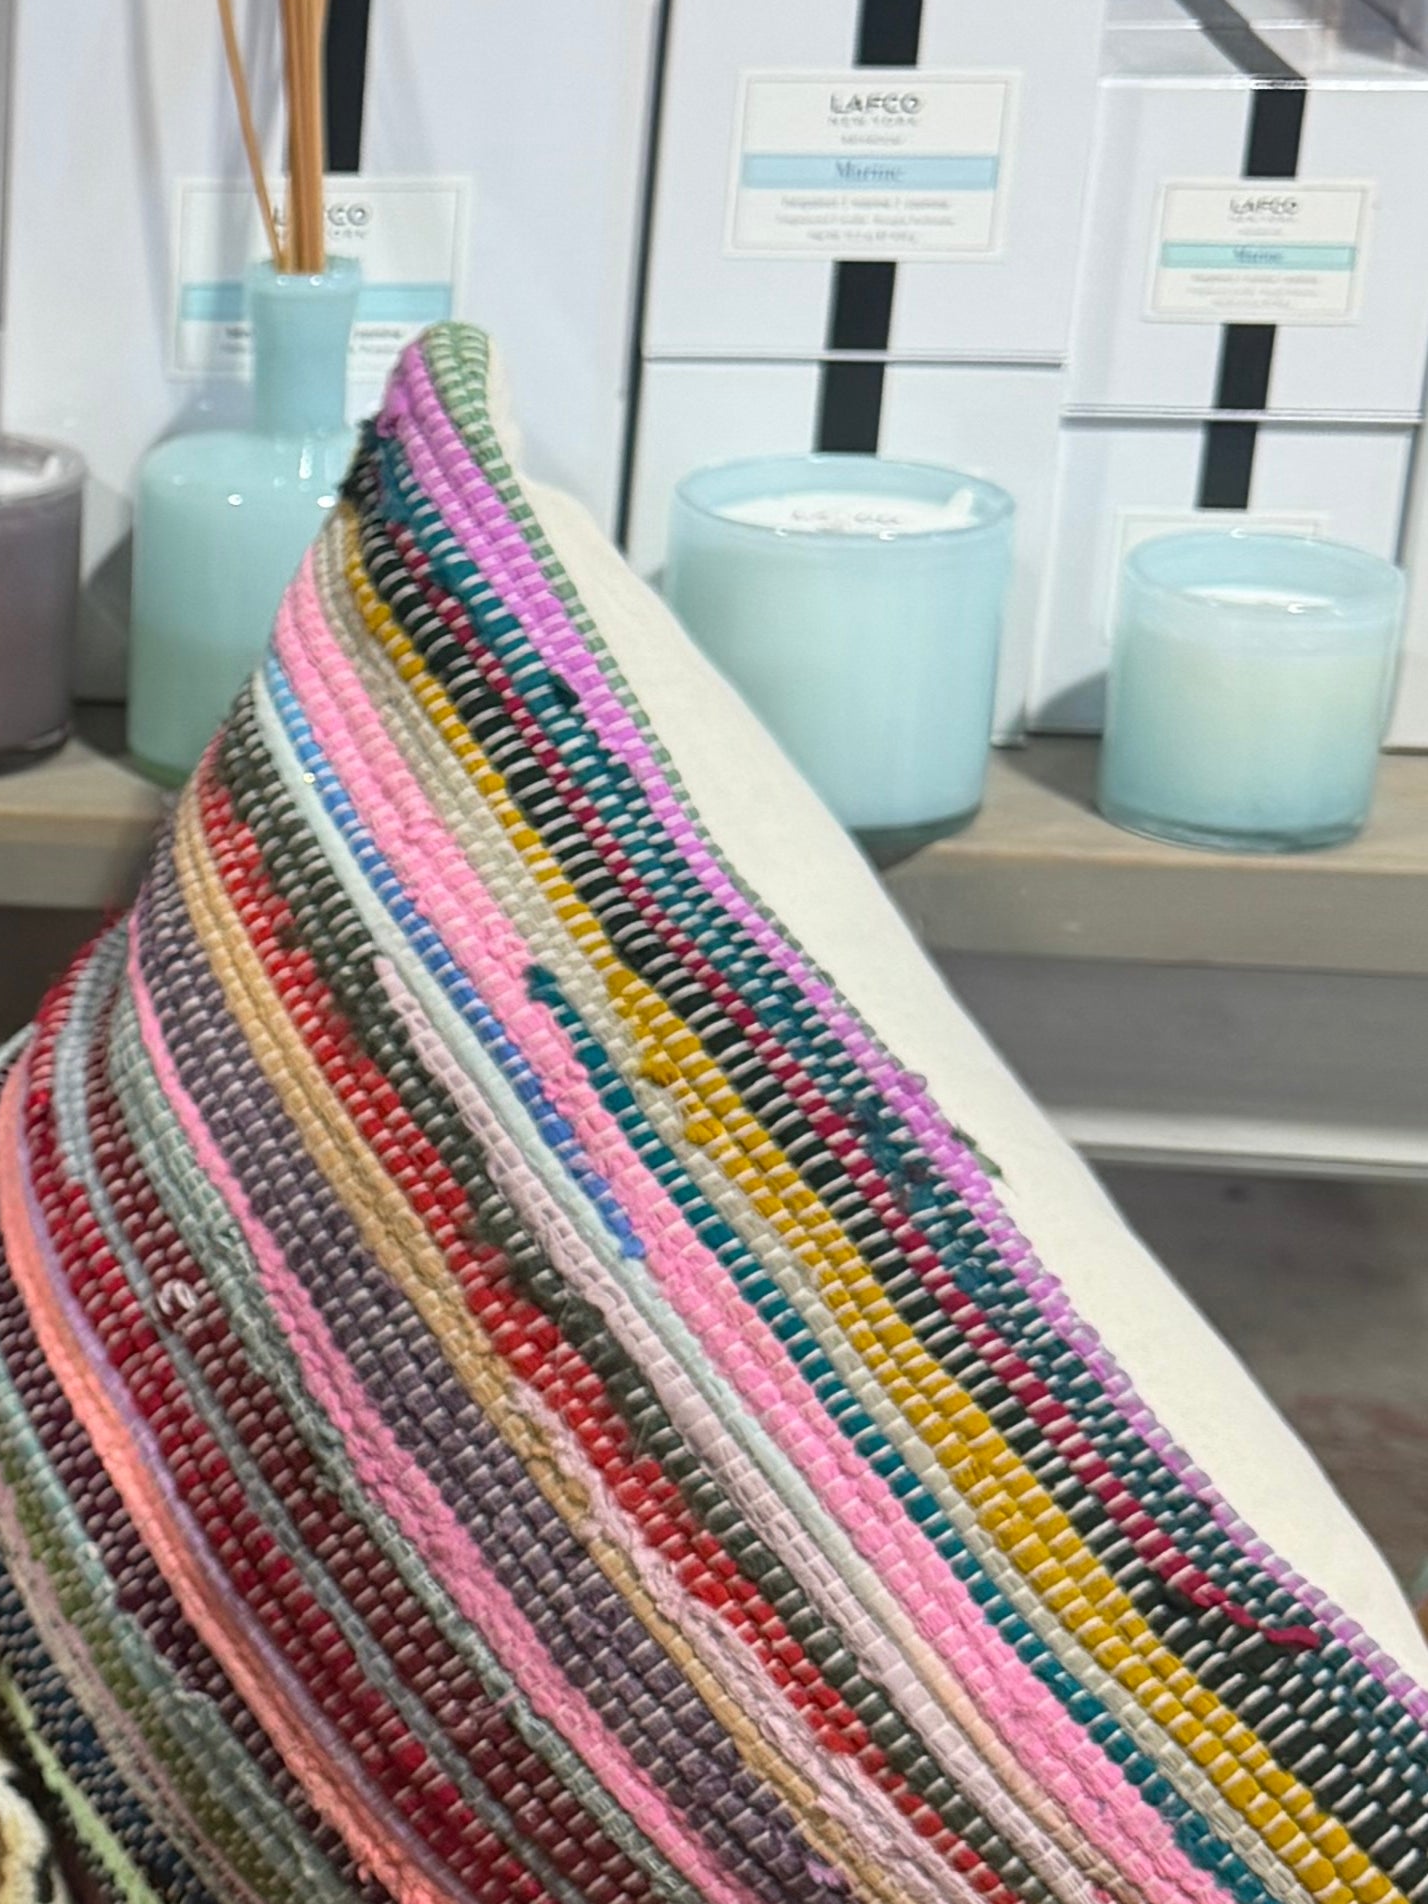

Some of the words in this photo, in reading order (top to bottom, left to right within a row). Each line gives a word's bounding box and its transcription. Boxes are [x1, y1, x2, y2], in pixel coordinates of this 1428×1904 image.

[830, 92, 921, 115] LAFCO
[835, 160, 905, 183] Marine
[1229, 197, 1299, 215] LAFCO
